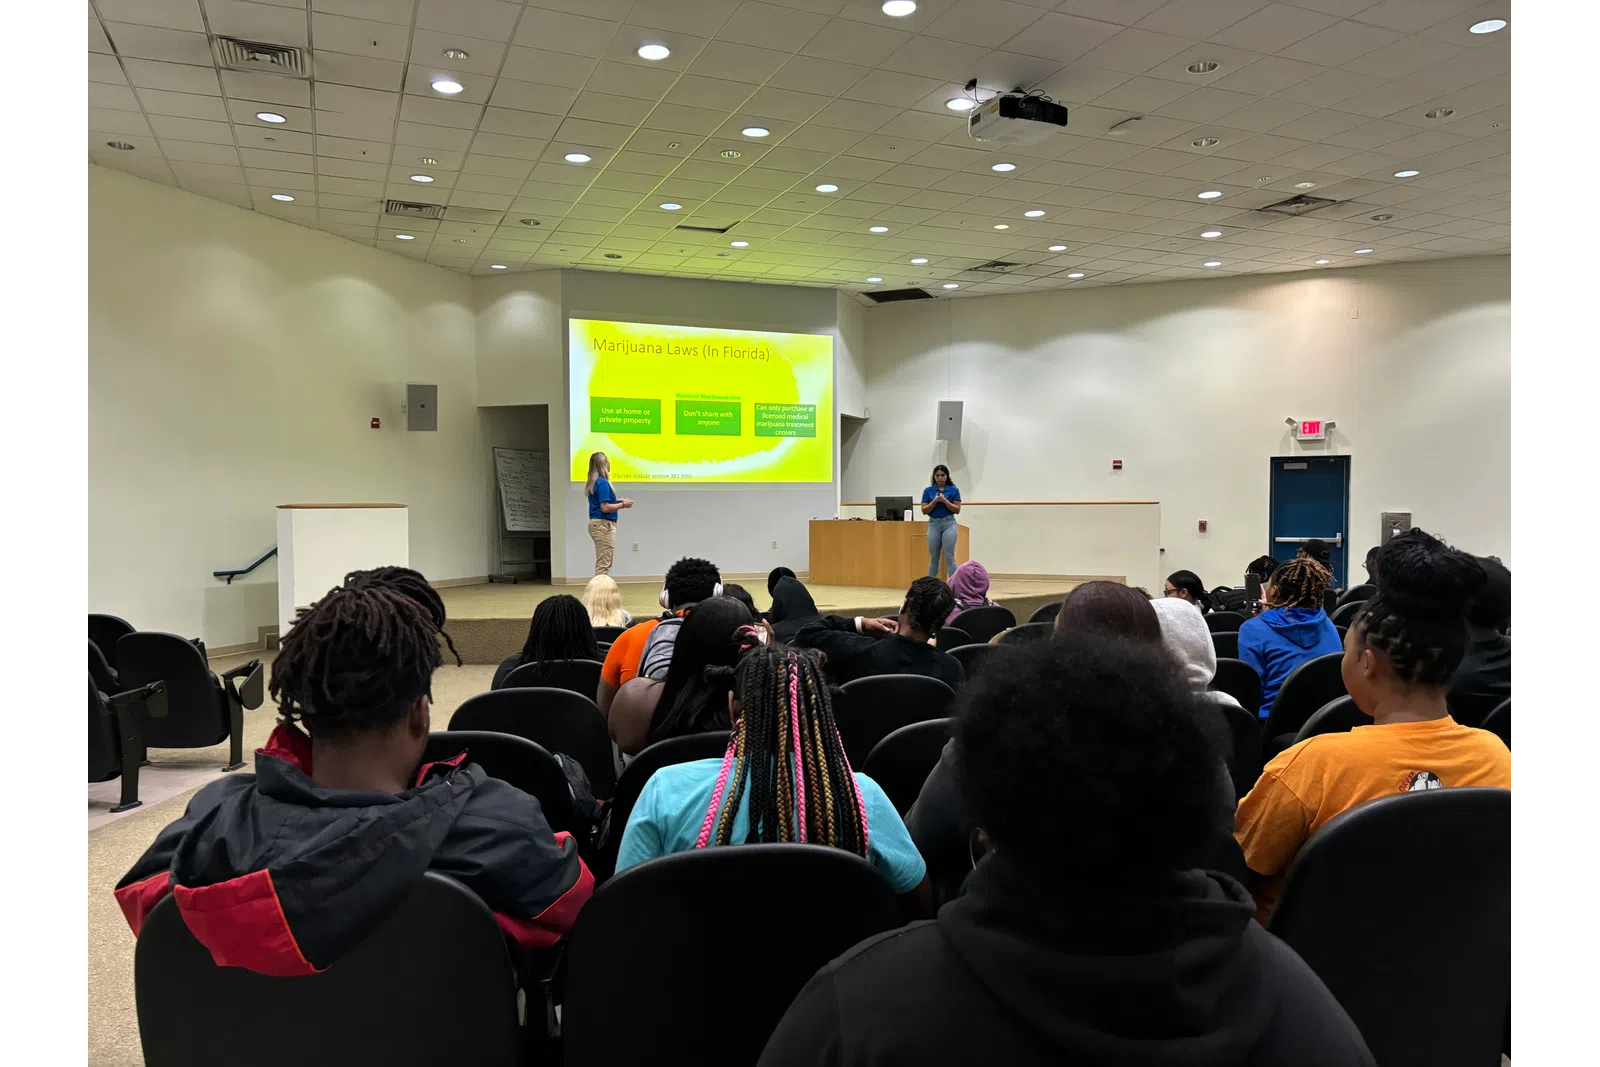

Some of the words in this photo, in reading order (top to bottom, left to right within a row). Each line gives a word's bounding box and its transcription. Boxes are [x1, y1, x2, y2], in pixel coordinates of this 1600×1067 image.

[593, 338, 662, 355] Marijuana
[667, 342, 698, 357] Laws
[702, 344, 719, 359] (In
[723, 346, 770, 362] Florida)
[768, 404, 781, 412] only
[702, 410, 719, 418] share
[762, 412, 785, 420] licensed
[599, 416, 622, 424] private
[623, 417, 651, 425] property
[697, 419, 720, 427] anyone
[756, 420, 785, 428] marijuana
[1302, 421, 1321, 435] EXIT
